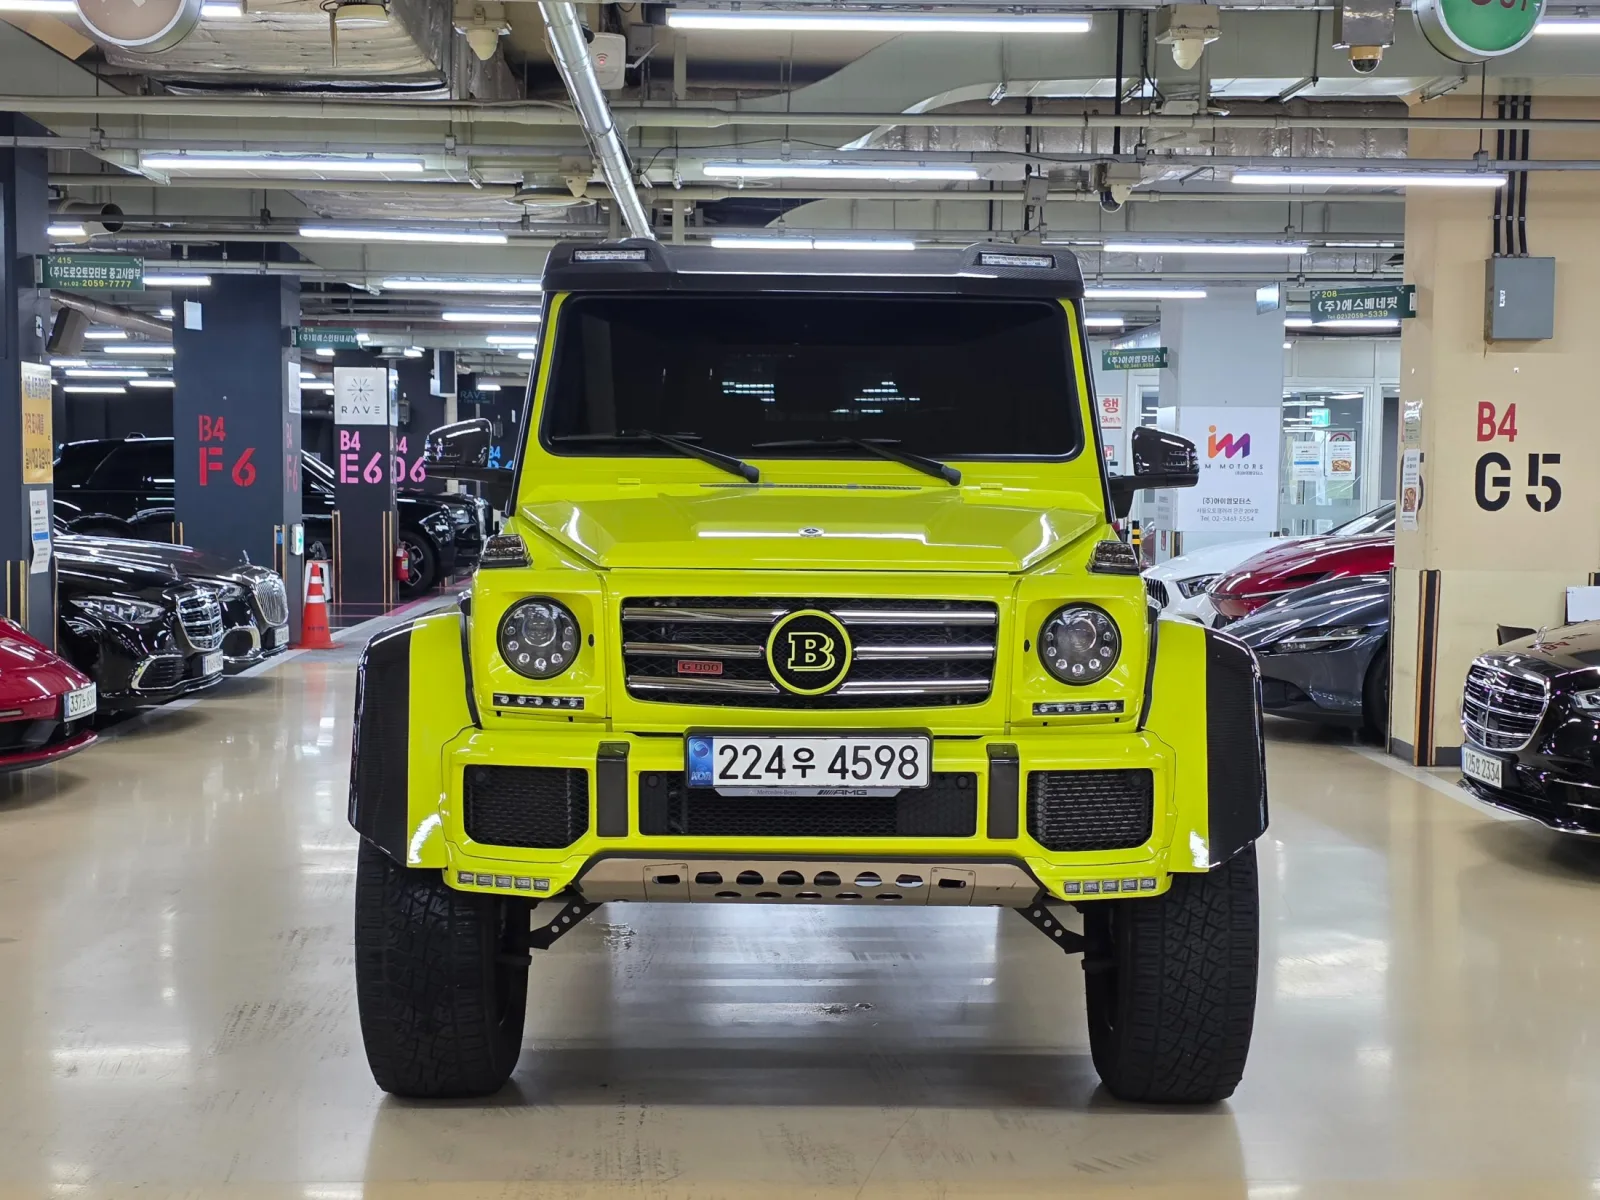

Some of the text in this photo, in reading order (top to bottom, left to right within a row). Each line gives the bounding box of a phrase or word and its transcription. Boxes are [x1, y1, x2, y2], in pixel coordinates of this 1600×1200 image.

[49, 266, 141, 281] (주)도로오토모티브 중고사업부
[1317, 296, 1398, 312] (주)에스베네핏
[1321, 290, 1337, 298] 208
[341, 405, 380, 414] RAVE
[198, 415, 226, 442] B4
[1477, 401, 1518, 442] B4
[340, 429, 361, 451] B4
[340, 451, 382, 484] E6
[787, 631, 835, 671] B
[681, 663, 719, 671] G 800
[718, 744, 919, 780] 224우 4598
